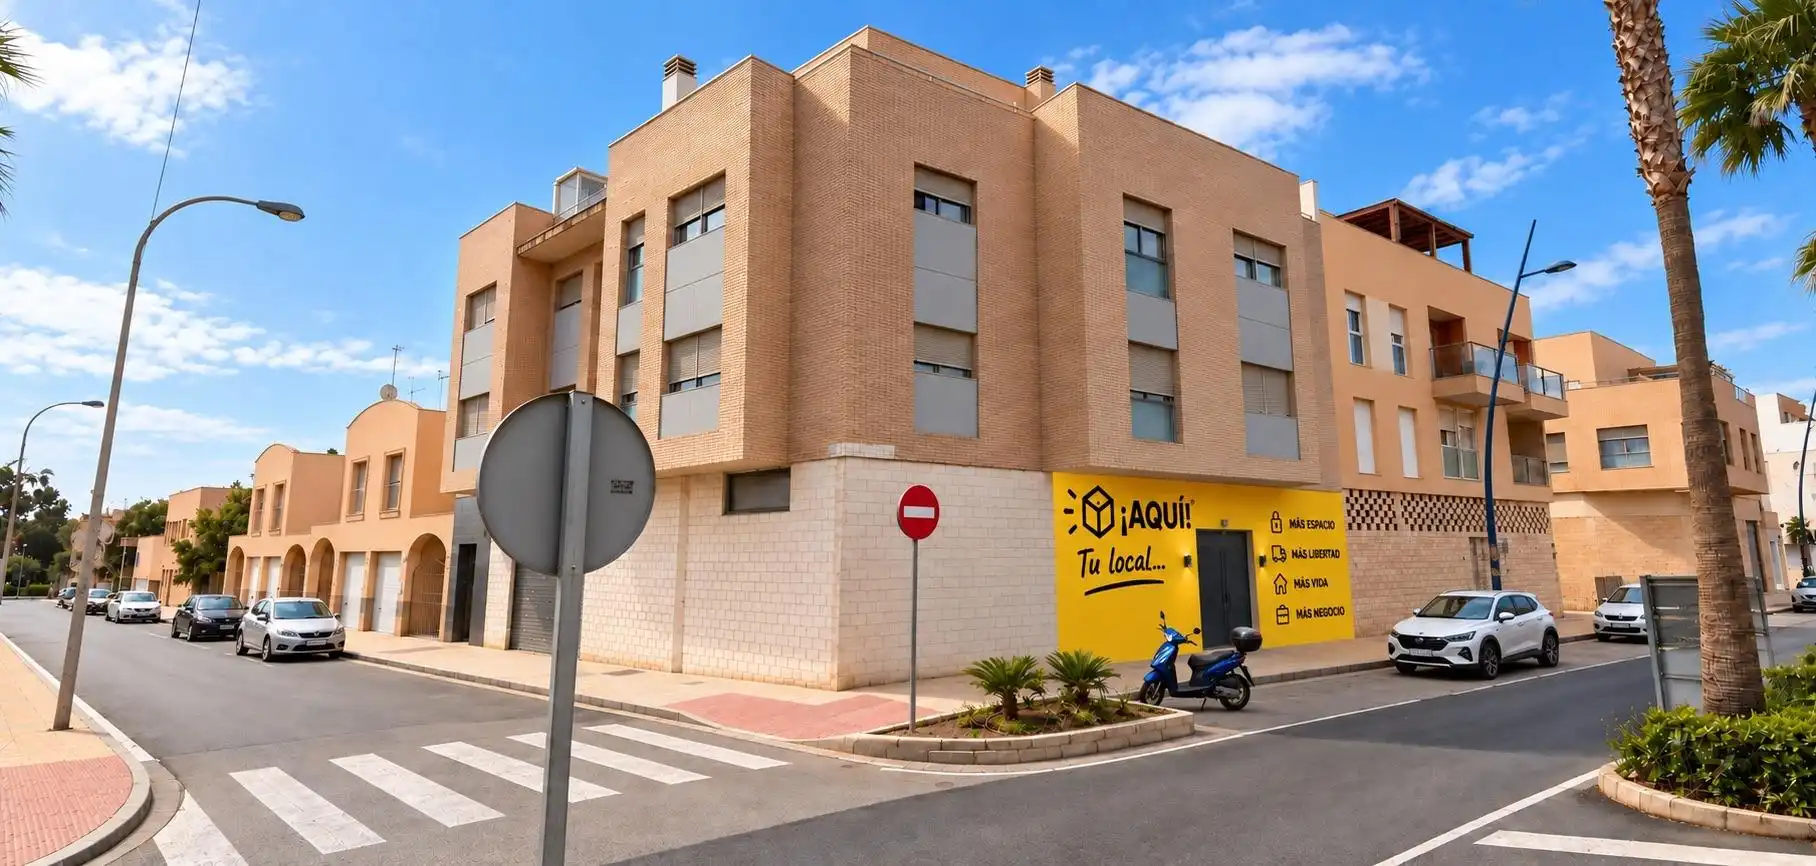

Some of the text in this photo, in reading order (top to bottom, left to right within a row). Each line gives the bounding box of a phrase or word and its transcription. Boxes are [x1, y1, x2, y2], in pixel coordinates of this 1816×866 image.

[1121, 495, 1191, 536] ¡AQUÍ!
[1289, 517, 1335, 530] MÁS ESPACIO
[1291, 547, 1340, 559] MÁS LIBERTAD
[1077, 545, 1166, 578] Tu local...
[1293, 576, 1329, 589] MÁS VIDA
[1296, 605, 1345, 619] MÁS NEGOCIO
